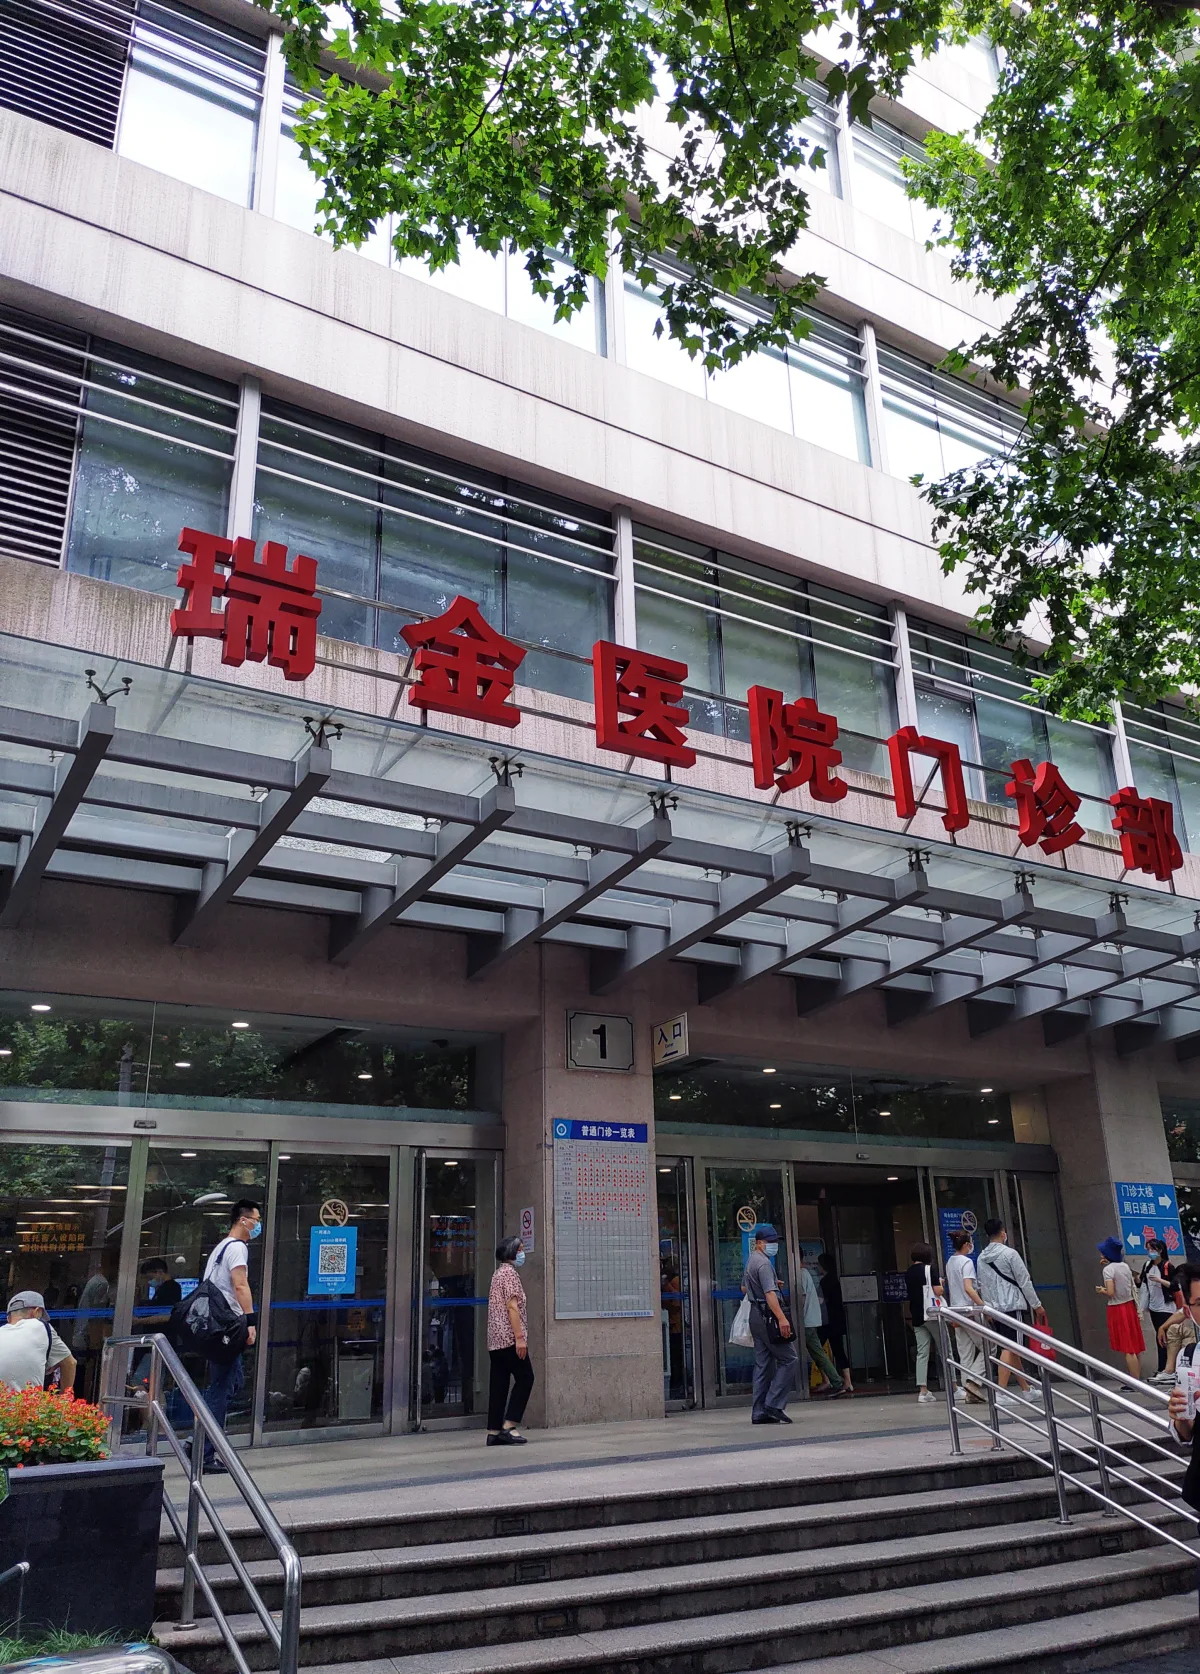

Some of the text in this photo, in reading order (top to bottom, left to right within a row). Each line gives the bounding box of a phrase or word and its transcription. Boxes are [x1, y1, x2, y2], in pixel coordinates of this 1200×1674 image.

[171, 527, 1185, 881] 瑞金医院门诊部
[592, 1023, 608, 1060] 1
[657, 1022, 682, 1046] 入口
[581, 1124, 636, 1139] 普通门诊一览表
[1120, 1184, 1154, 1198] 门诊大楼
[1123, 1201, 1157, 1215] 周日通道
